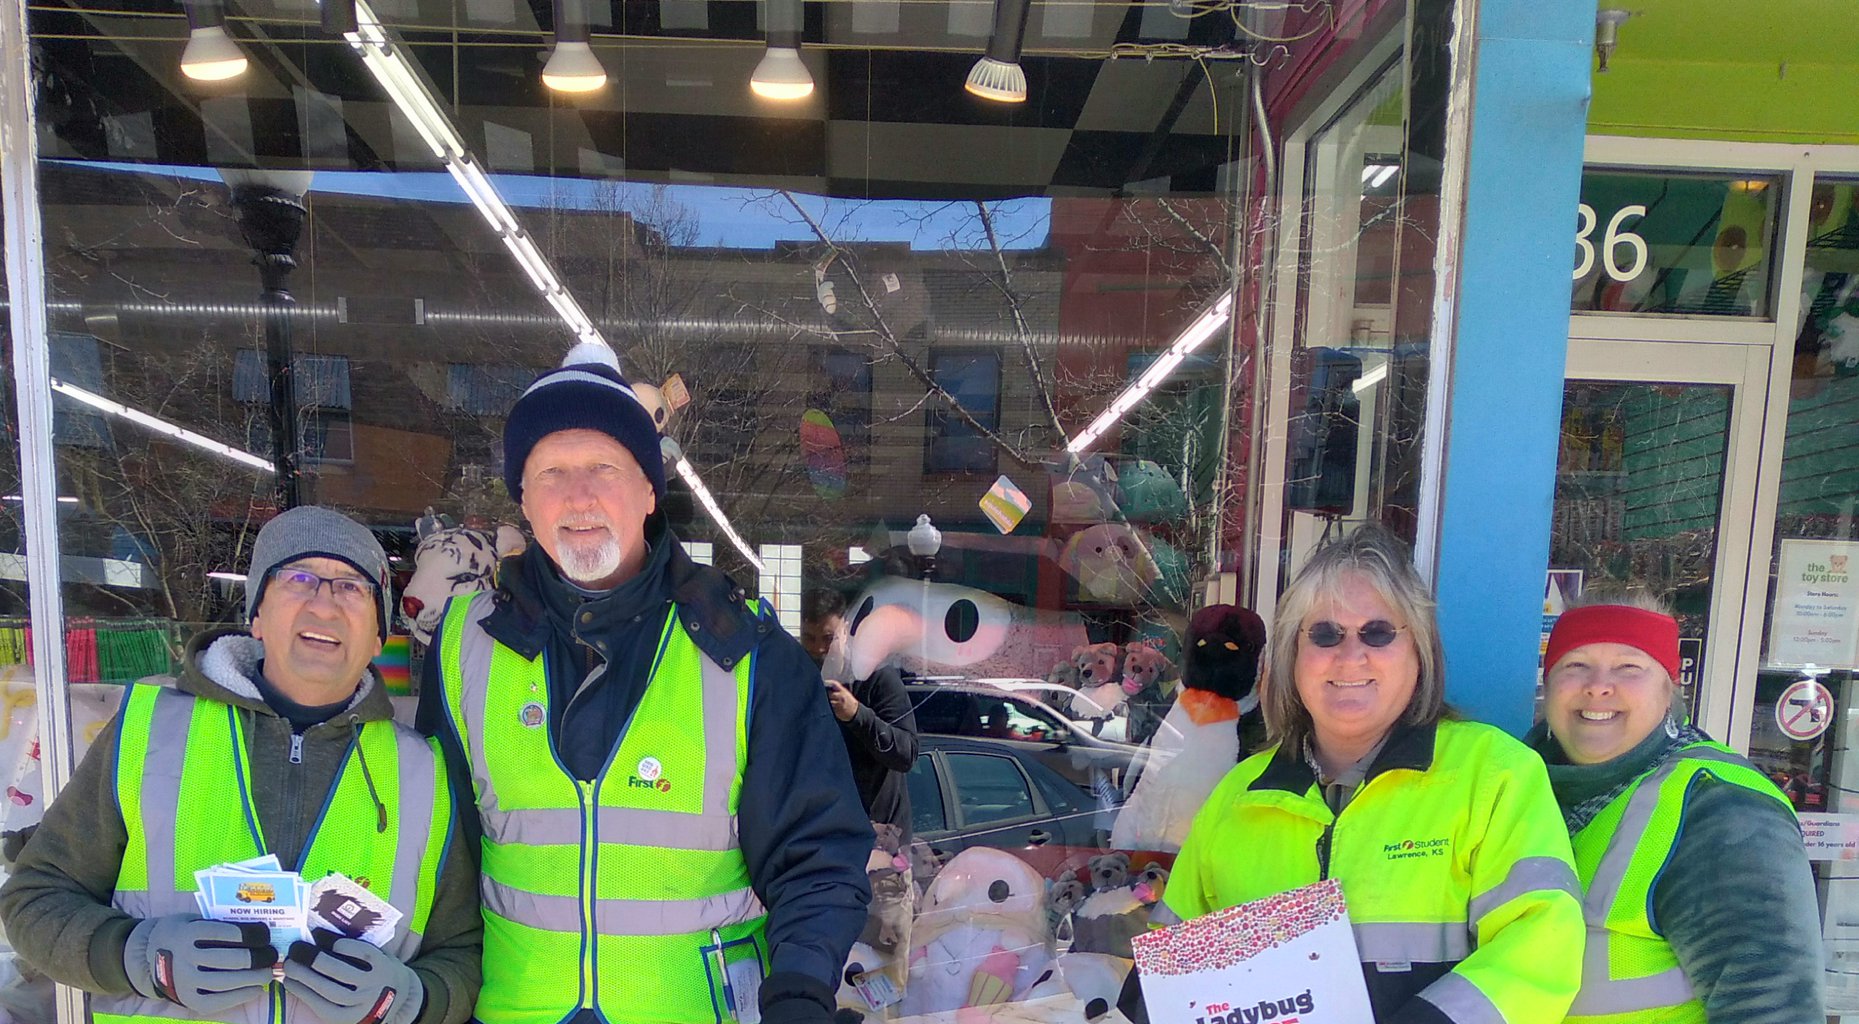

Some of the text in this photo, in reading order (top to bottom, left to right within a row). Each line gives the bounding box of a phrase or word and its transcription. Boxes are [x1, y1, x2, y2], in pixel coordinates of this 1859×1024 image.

[1808, 563, 1825, 572] the
[1802, 573, 1848, 584] toy store
[1680, 657, 1694, 699] PUL
[629, 776, 654, 789] First
[1384, 838, 1449, 852] First Student
[1388, 851, 1428, 860] Lawrence,
[1206, 1002, 1230, 1016] The
